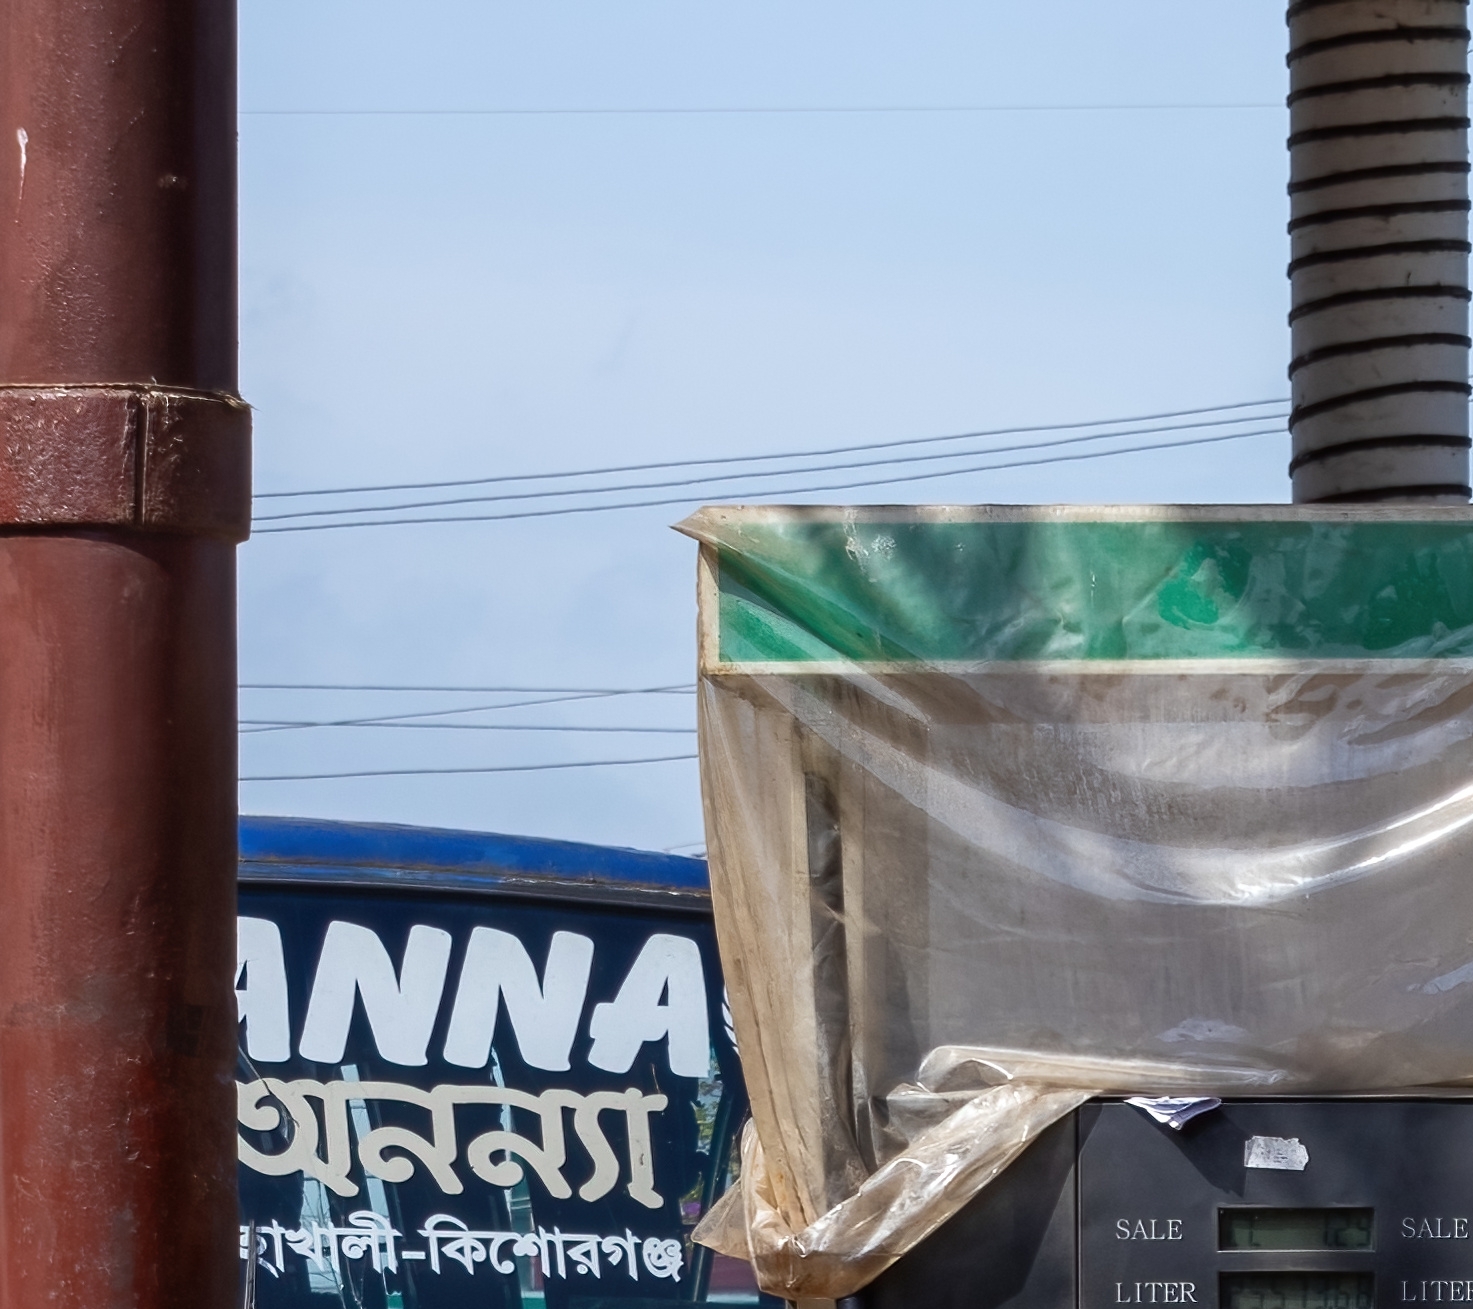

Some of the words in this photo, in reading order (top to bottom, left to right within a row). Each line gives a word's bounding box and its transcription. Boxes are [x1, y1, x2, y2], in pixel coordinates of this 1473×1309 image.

[235, 1077, 668, 1209] অনন্যা
[1115, 1219, 1182, 1241] SALE
[1401, 1217, 1469, 1240] SALE
[239, 1210, 684, 1282] হাখালী-কিশোরগঞ্জ
[1115, 1282, 1198, 1304] LITER
